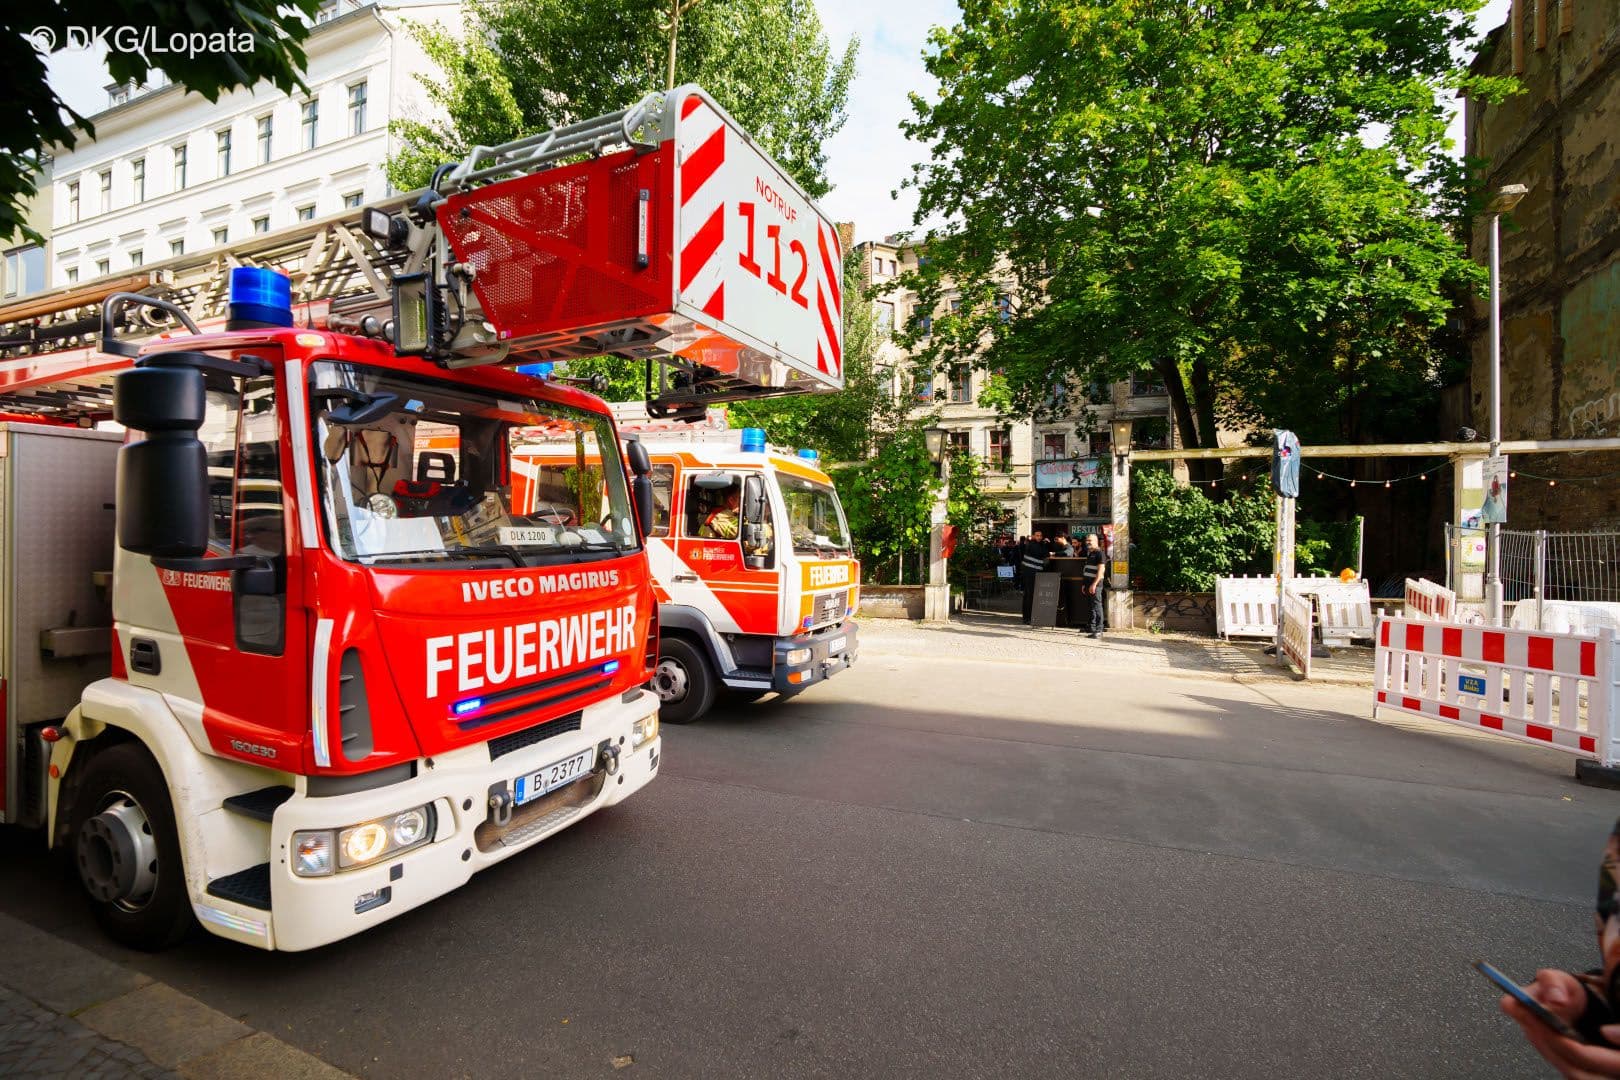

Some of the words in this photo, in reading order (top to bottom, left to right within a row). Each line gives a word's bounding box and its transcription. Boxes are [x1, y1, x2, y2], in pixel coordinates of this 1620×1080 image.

[756, 176, 797, 223] NOTRUF
[738, 202, 808, 310] 112
[183, 572, 232, 592] FEUERWEHR
[462, 577, 535, 602] IVECO
[539, 570, 619, 594] MAGIRUS
[810, 565, 849, 587] FEUERWEHR
[426, 605, 637, 699] FEUERWEHR
[231, 740, 277, 758] 160E30
[534, 773, 543, 791] B
[551, 756, 584, 784] 2377
